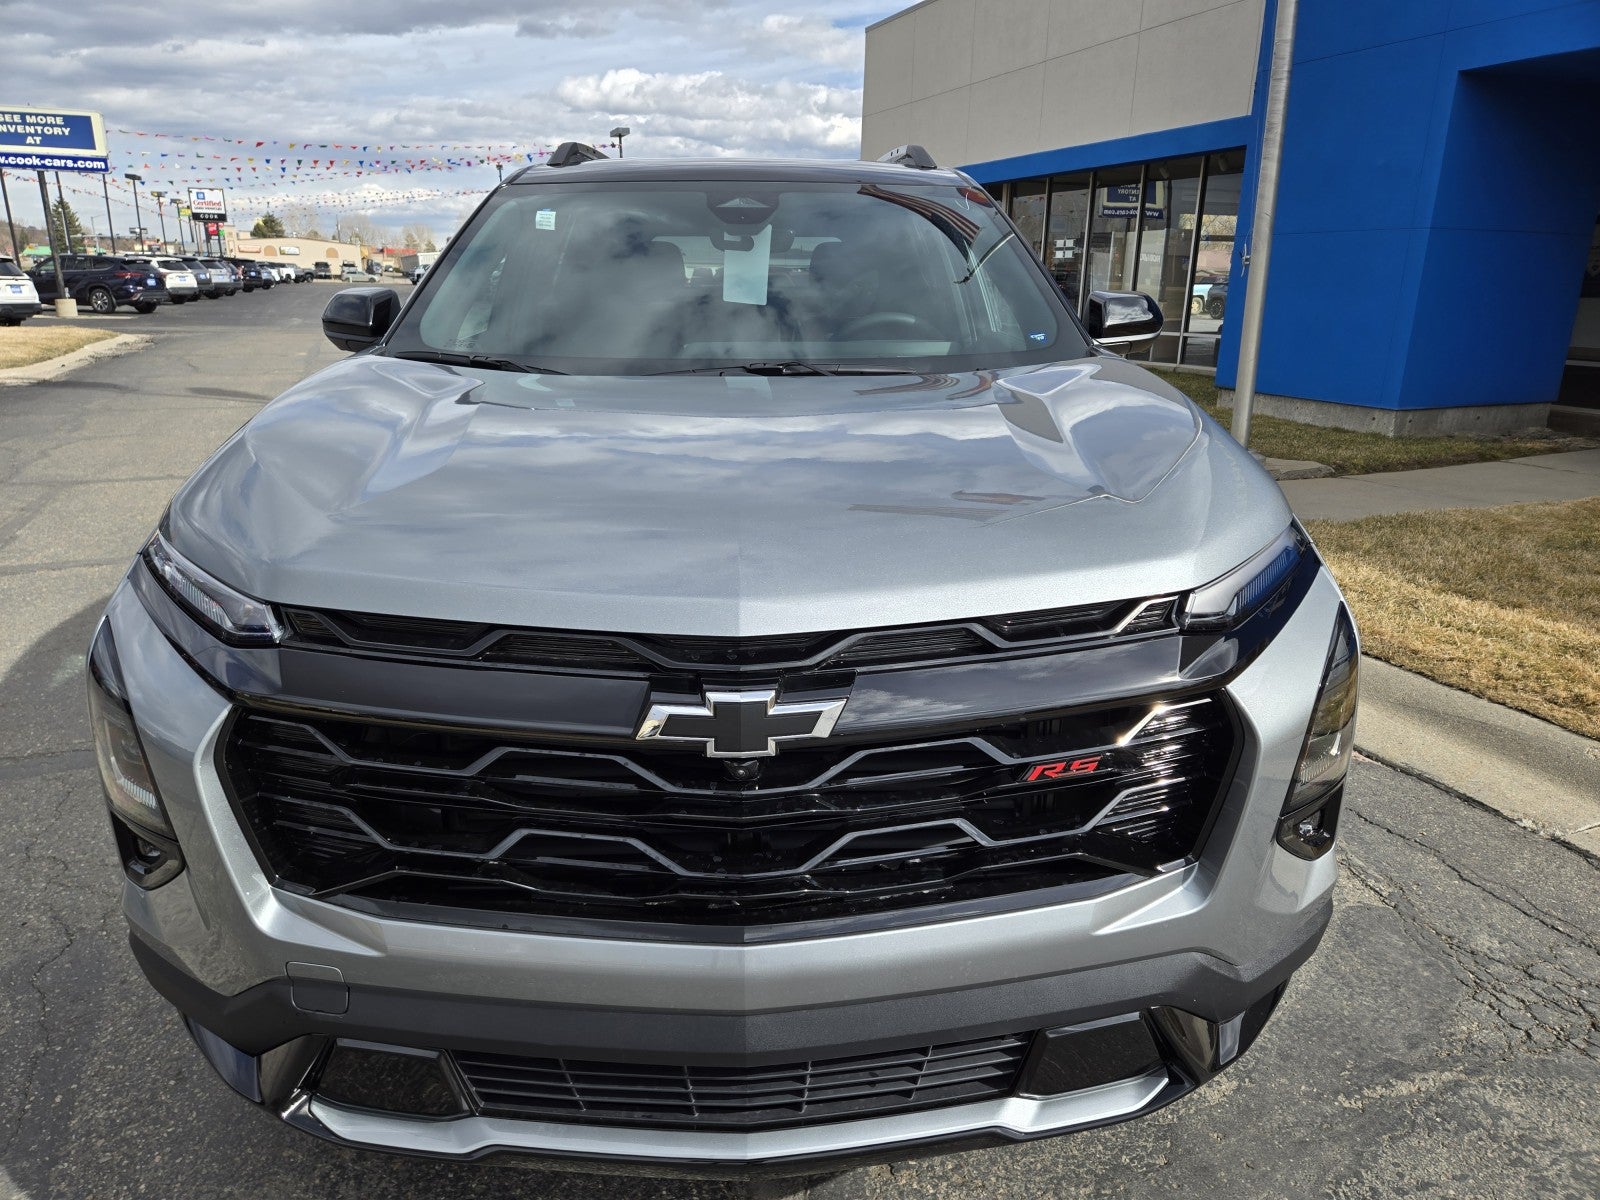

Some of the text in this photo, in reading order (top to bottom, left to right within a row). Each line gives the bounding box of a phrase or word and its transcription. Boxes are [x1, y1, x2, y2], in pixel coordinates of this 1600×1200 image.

[0, 114, 64, 125] SEE MORE
[0, 124, 70, 136] NVENTORY
[26, 136, 42, 144] AT
[1026, 755, 1103, 781] RS
